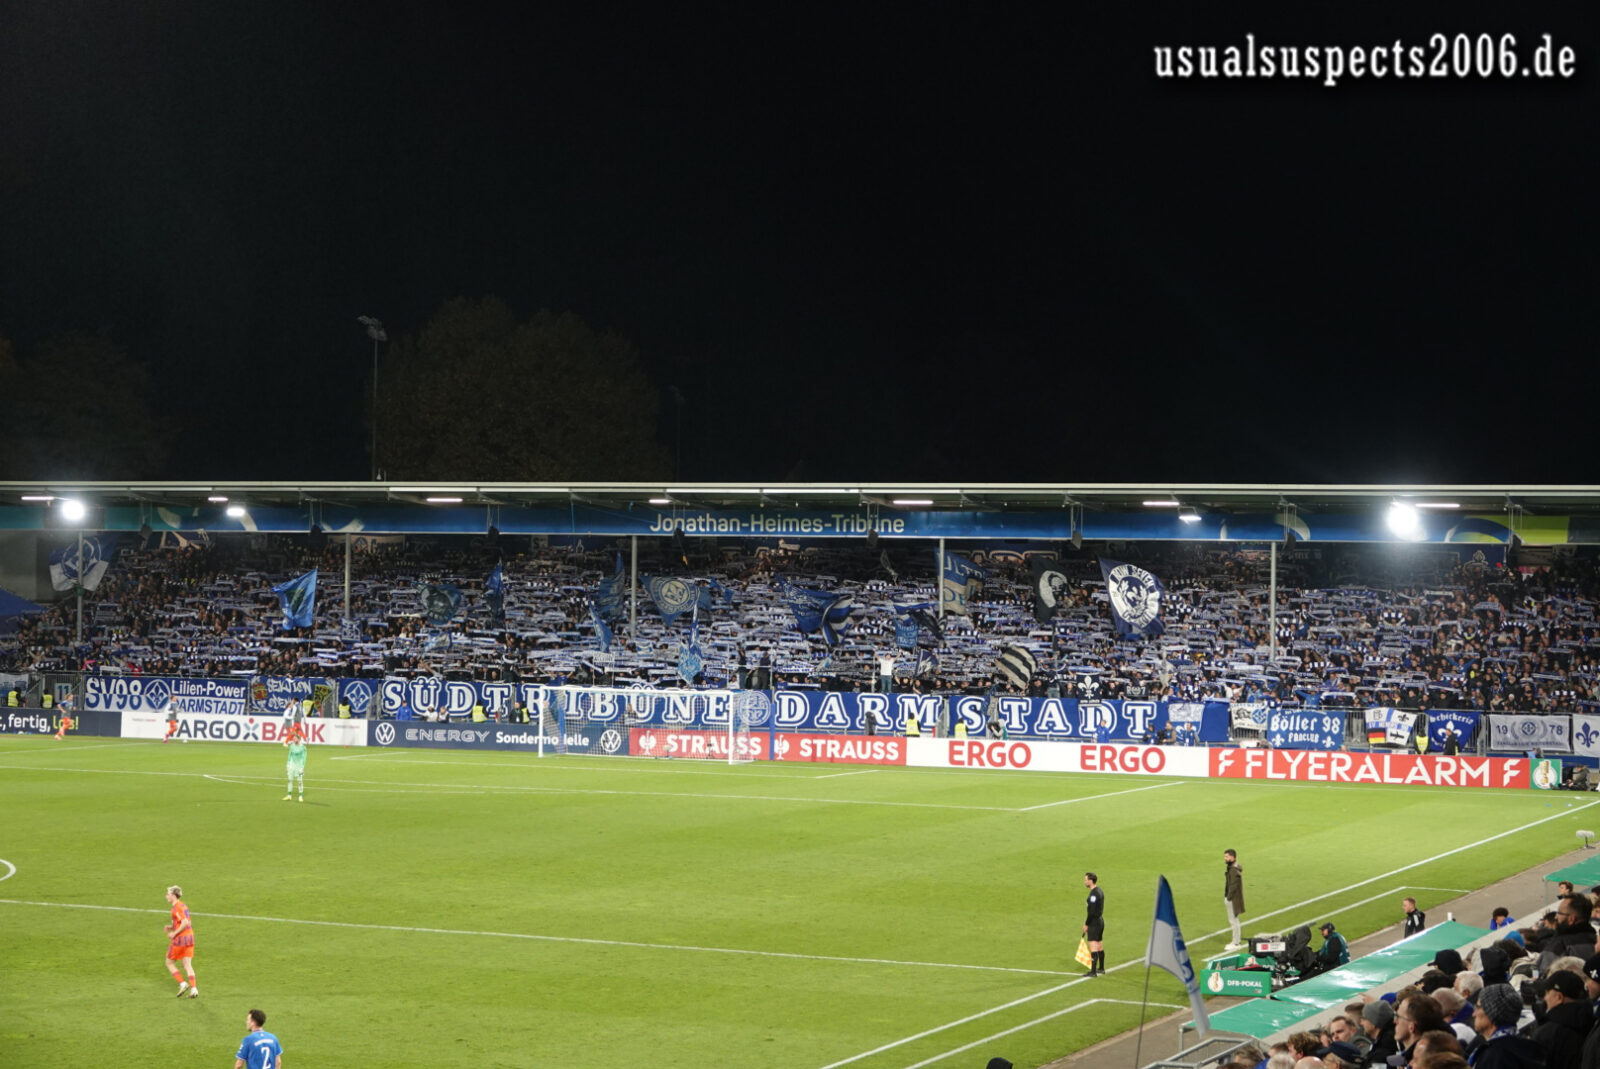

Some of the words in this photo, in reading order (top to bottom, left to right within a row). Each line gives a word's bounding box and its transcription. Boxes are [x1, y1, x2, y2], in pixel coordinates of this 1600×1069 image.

[650, 513, 905, 534] Jonathan-Heimes-Tribüne
[86, 677, 142, 711] SV98
[171, 679, 246, 698] Lilien-Power
[175, 698, 245, 715] ARMSTADT
[775, 691, 1157, 738] DARMSTADT
[8, 713, 51, 733] fertig,
[1270, 713, 1318, 732] Böller
[1322, 716, 1341, 735] 98
[1496, 724, 1509, 735] 19
[1548, 724, 1563, 736] 78
[405, 728, 490, 742] ENERGY
[666, 734, 762, 756] STRAUSS
[800, 738, 899, 760] STRAUSS
[948, 740, 1032, 768] ERGO
[1080, 744, 1166, 773] ERGO
[1245, 750, 1490, 787] FLYERALARM
[1227, 980, 1263, 988] DFB-POKAL
[261, 1047, 272, 1069] 2
